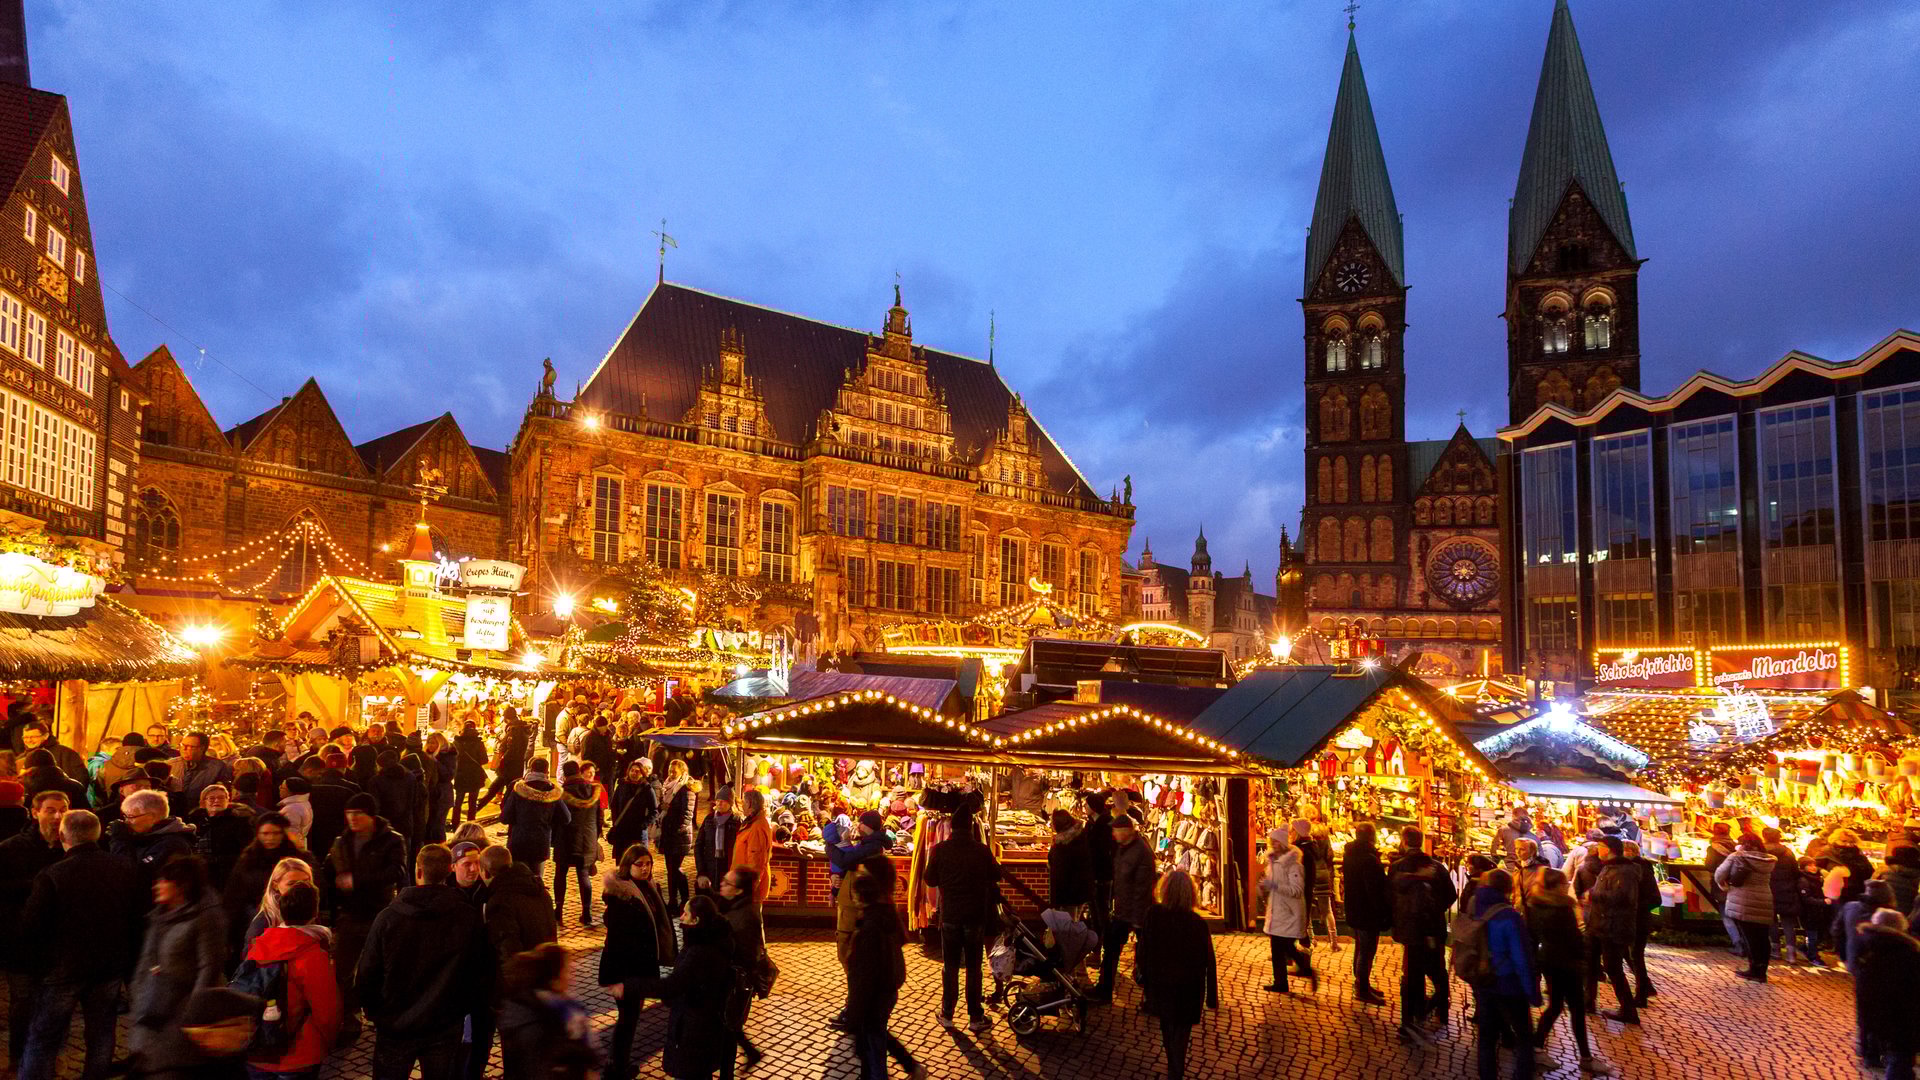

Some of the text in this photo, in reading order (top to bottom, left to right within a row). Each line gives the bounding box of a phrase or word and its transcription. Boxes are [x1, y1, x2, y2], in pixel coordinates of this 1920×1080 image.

[51, 502, 72, 515] MARKT
[1599, 653, 1694, 681] Schokofrüchte
[1752, 649, 1837, 678] Mandeln
